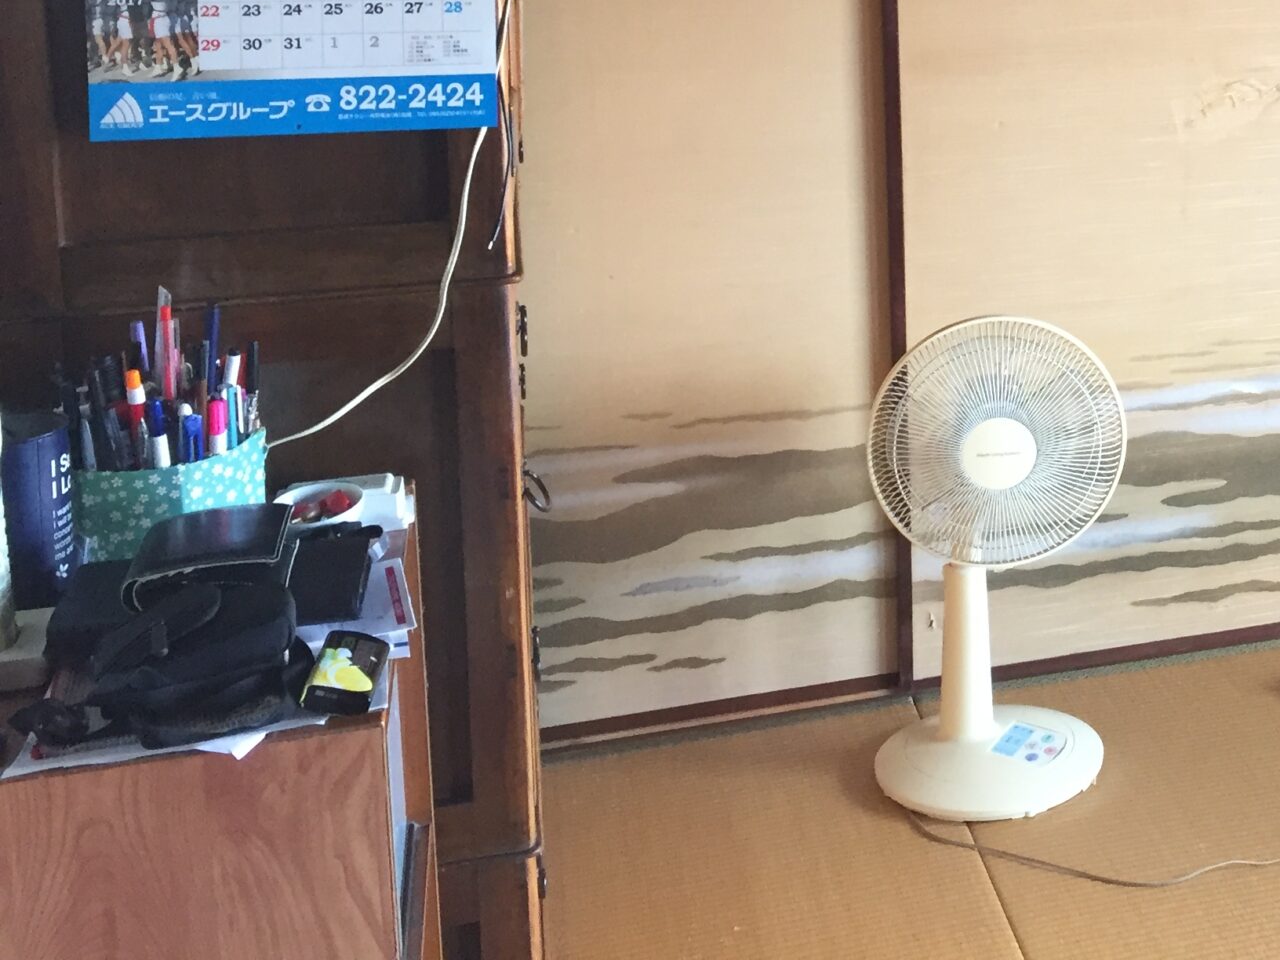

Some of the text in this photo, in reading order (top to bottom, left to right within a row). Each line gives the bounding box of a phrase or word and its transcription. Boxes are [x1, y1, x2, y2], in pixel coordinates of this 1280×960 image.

[200, 1, 462, 17] 22 23 24 25 26 27 28
[201, 36, 379, 51] 29 30 31 1 2
[339, 82, 484, 110] 822-2424
[149, 100, 295, 122] エースグループ
